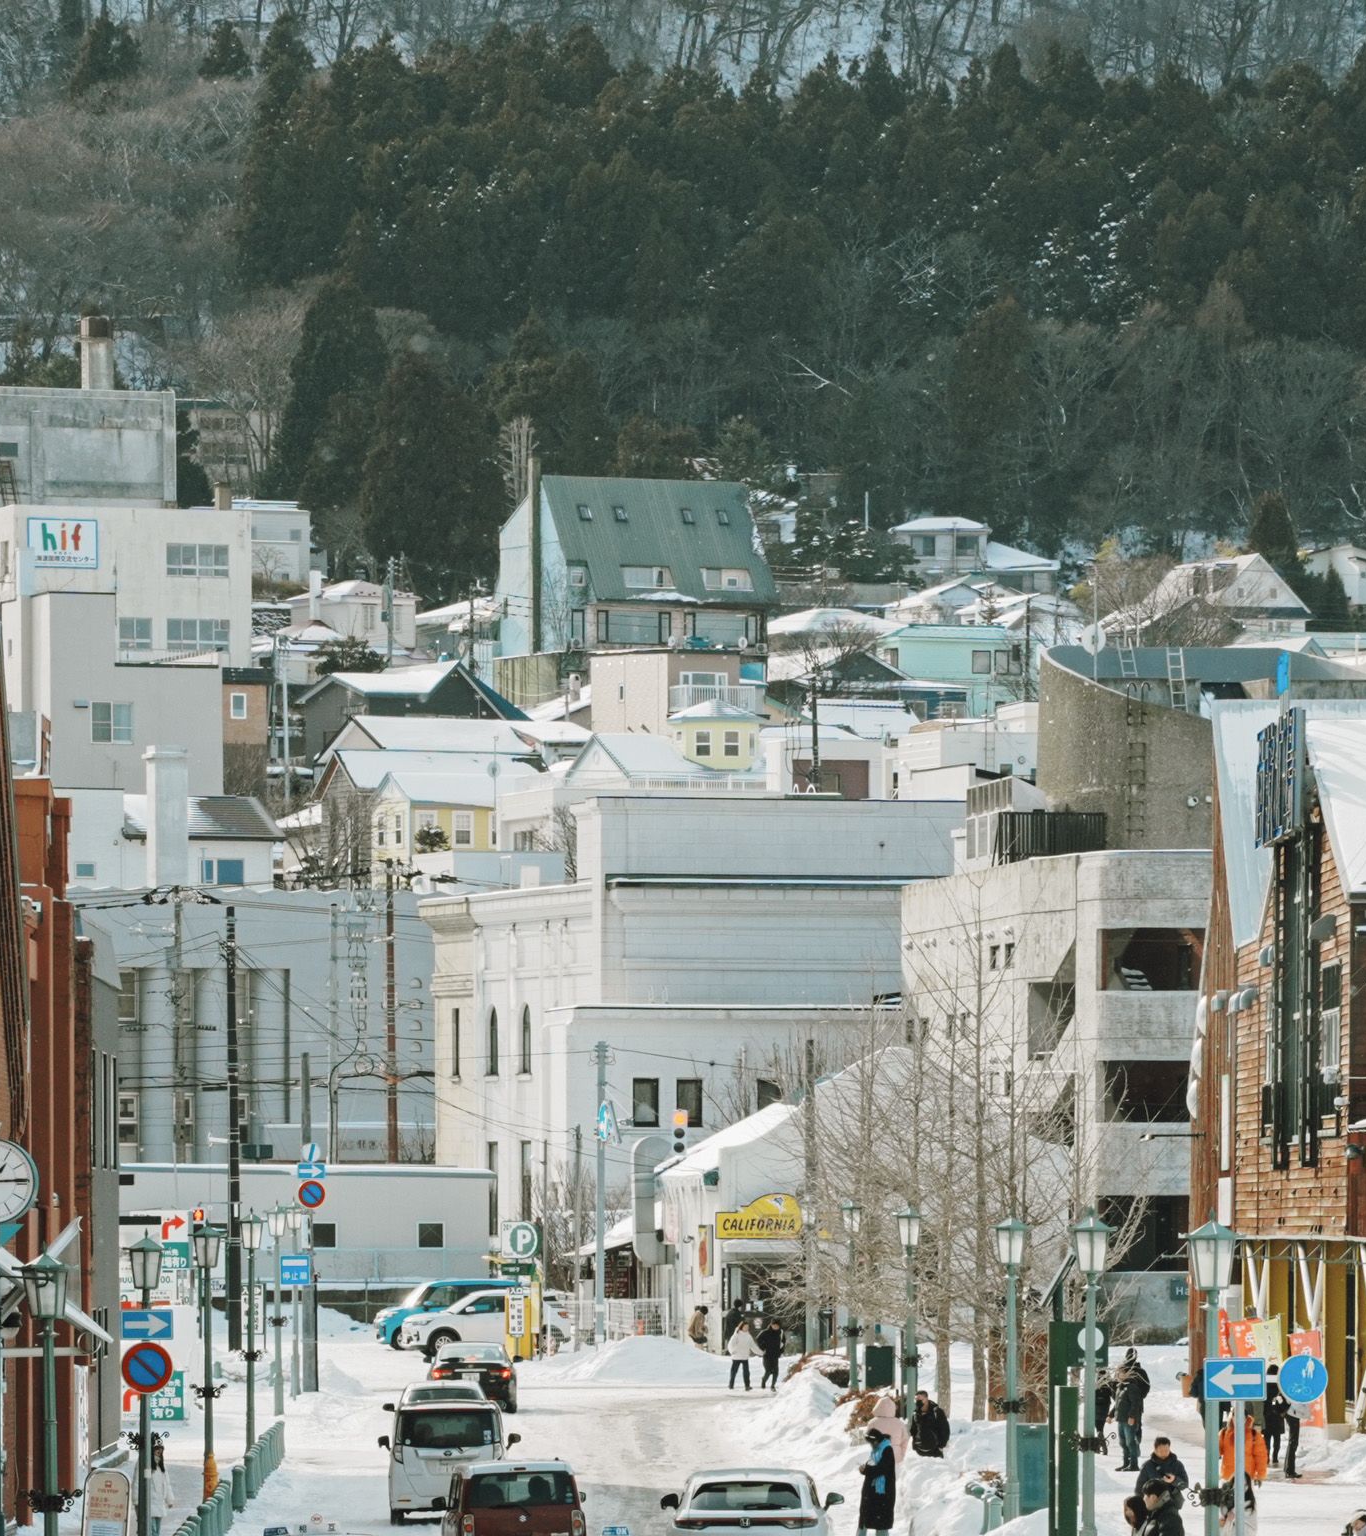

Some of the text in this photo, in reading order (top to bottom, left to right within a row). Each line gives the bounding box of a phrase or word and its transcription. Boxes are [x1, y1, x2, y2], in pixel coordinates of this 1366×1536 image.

[41, 522, 81, 551] hif
[722, 1218, 796, 1231] CALIFORNIA
[516, 1229, 532, 1252] P
